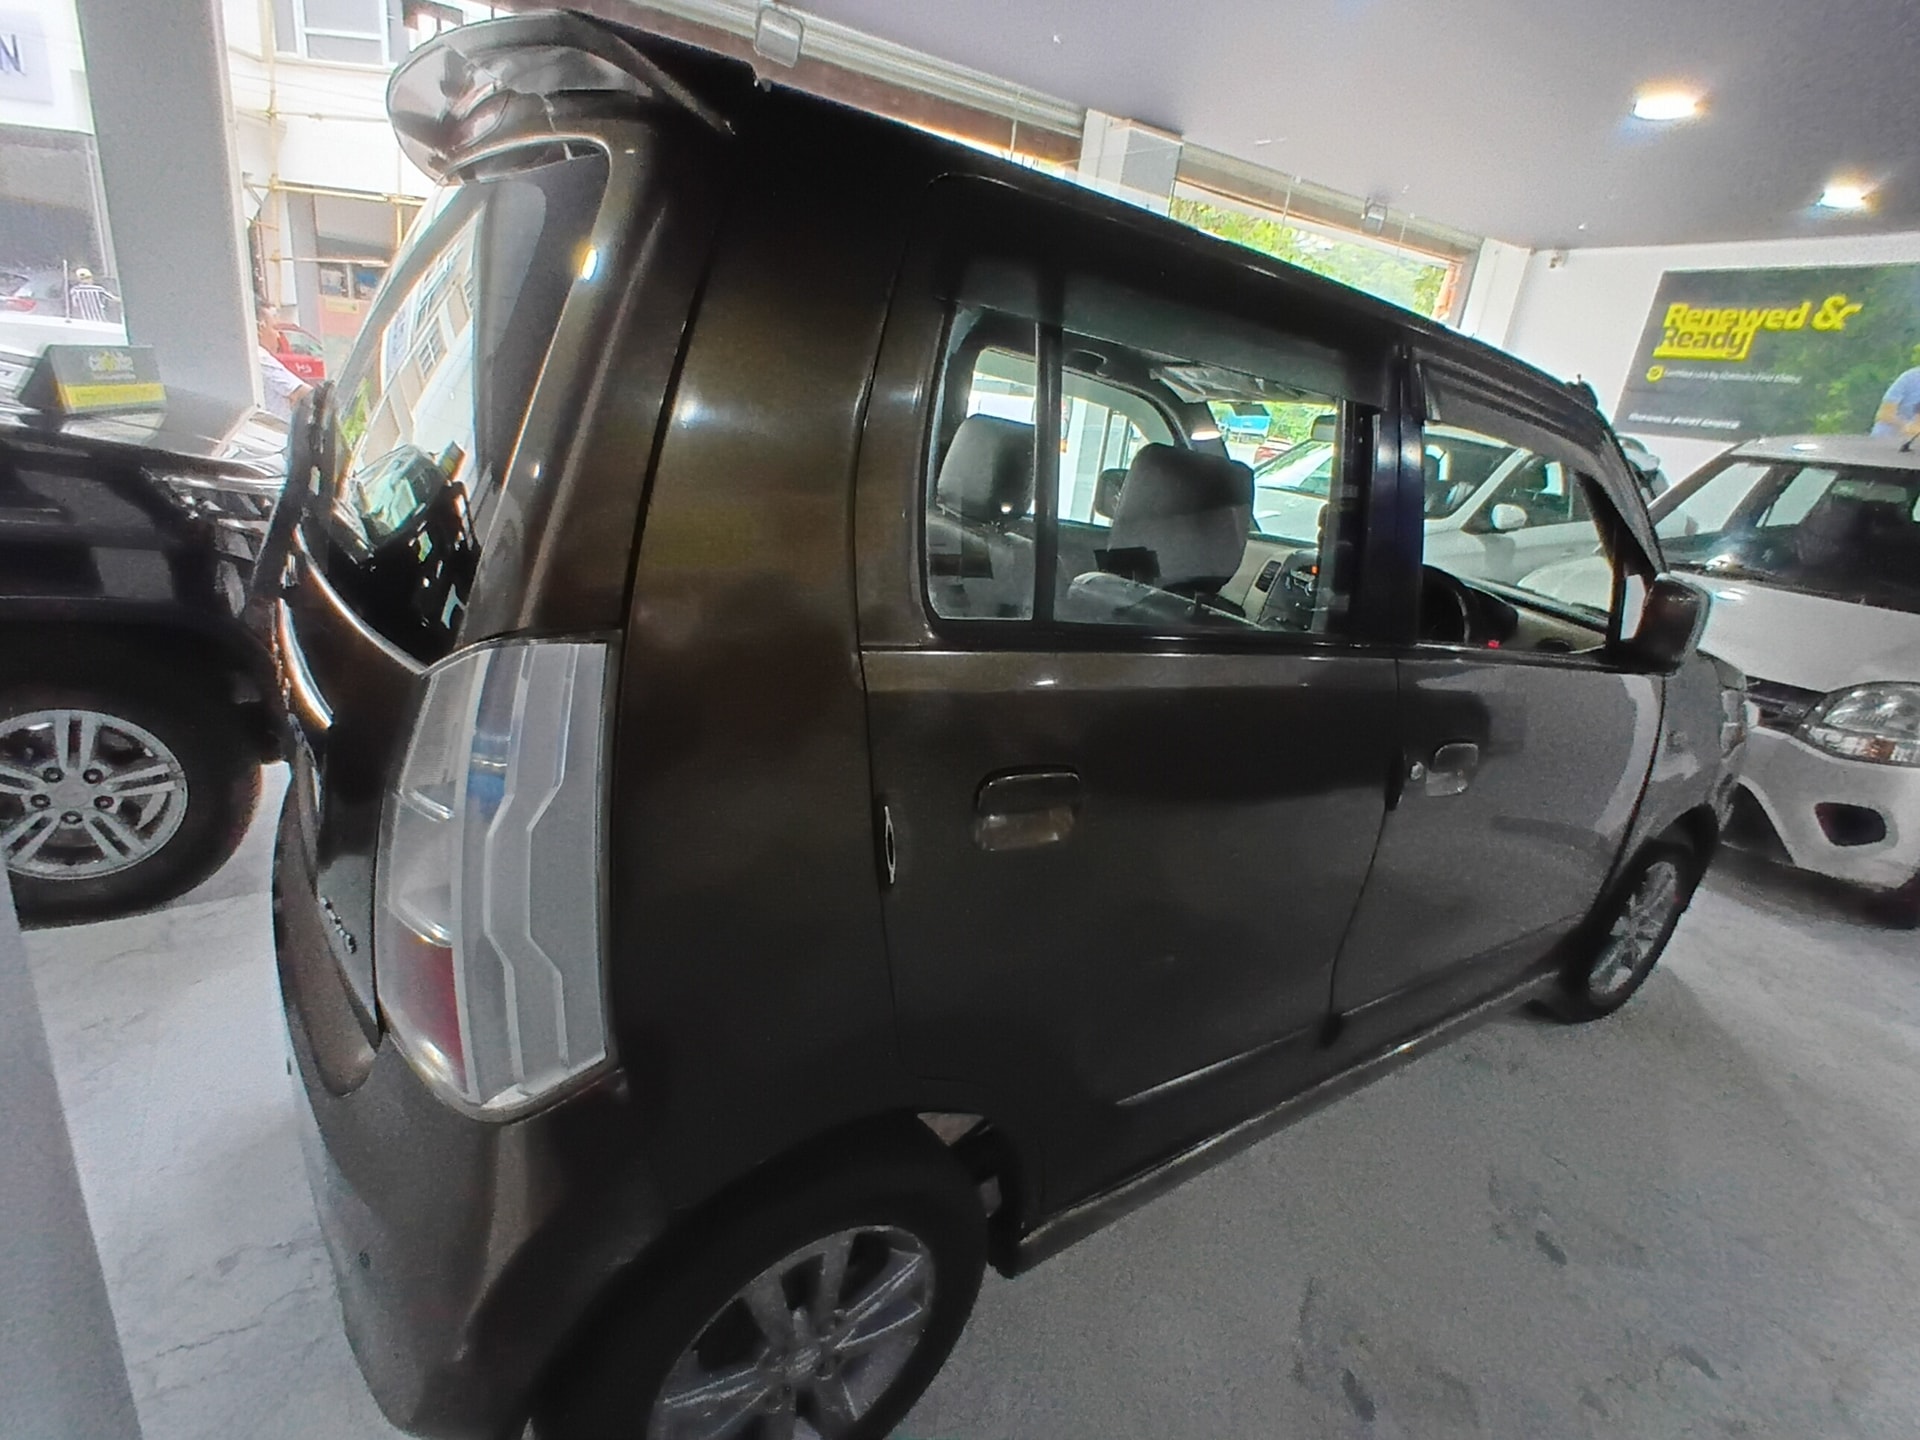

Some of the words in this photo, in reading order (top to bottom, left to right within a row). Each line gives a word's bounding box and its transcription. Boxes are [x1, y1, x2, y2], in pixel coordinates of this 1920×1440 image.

[1663, 301, 1811, 331] Renewed
[1811, 293, 1863, 331] &
[1662, 327, 1750, 358] Ready
